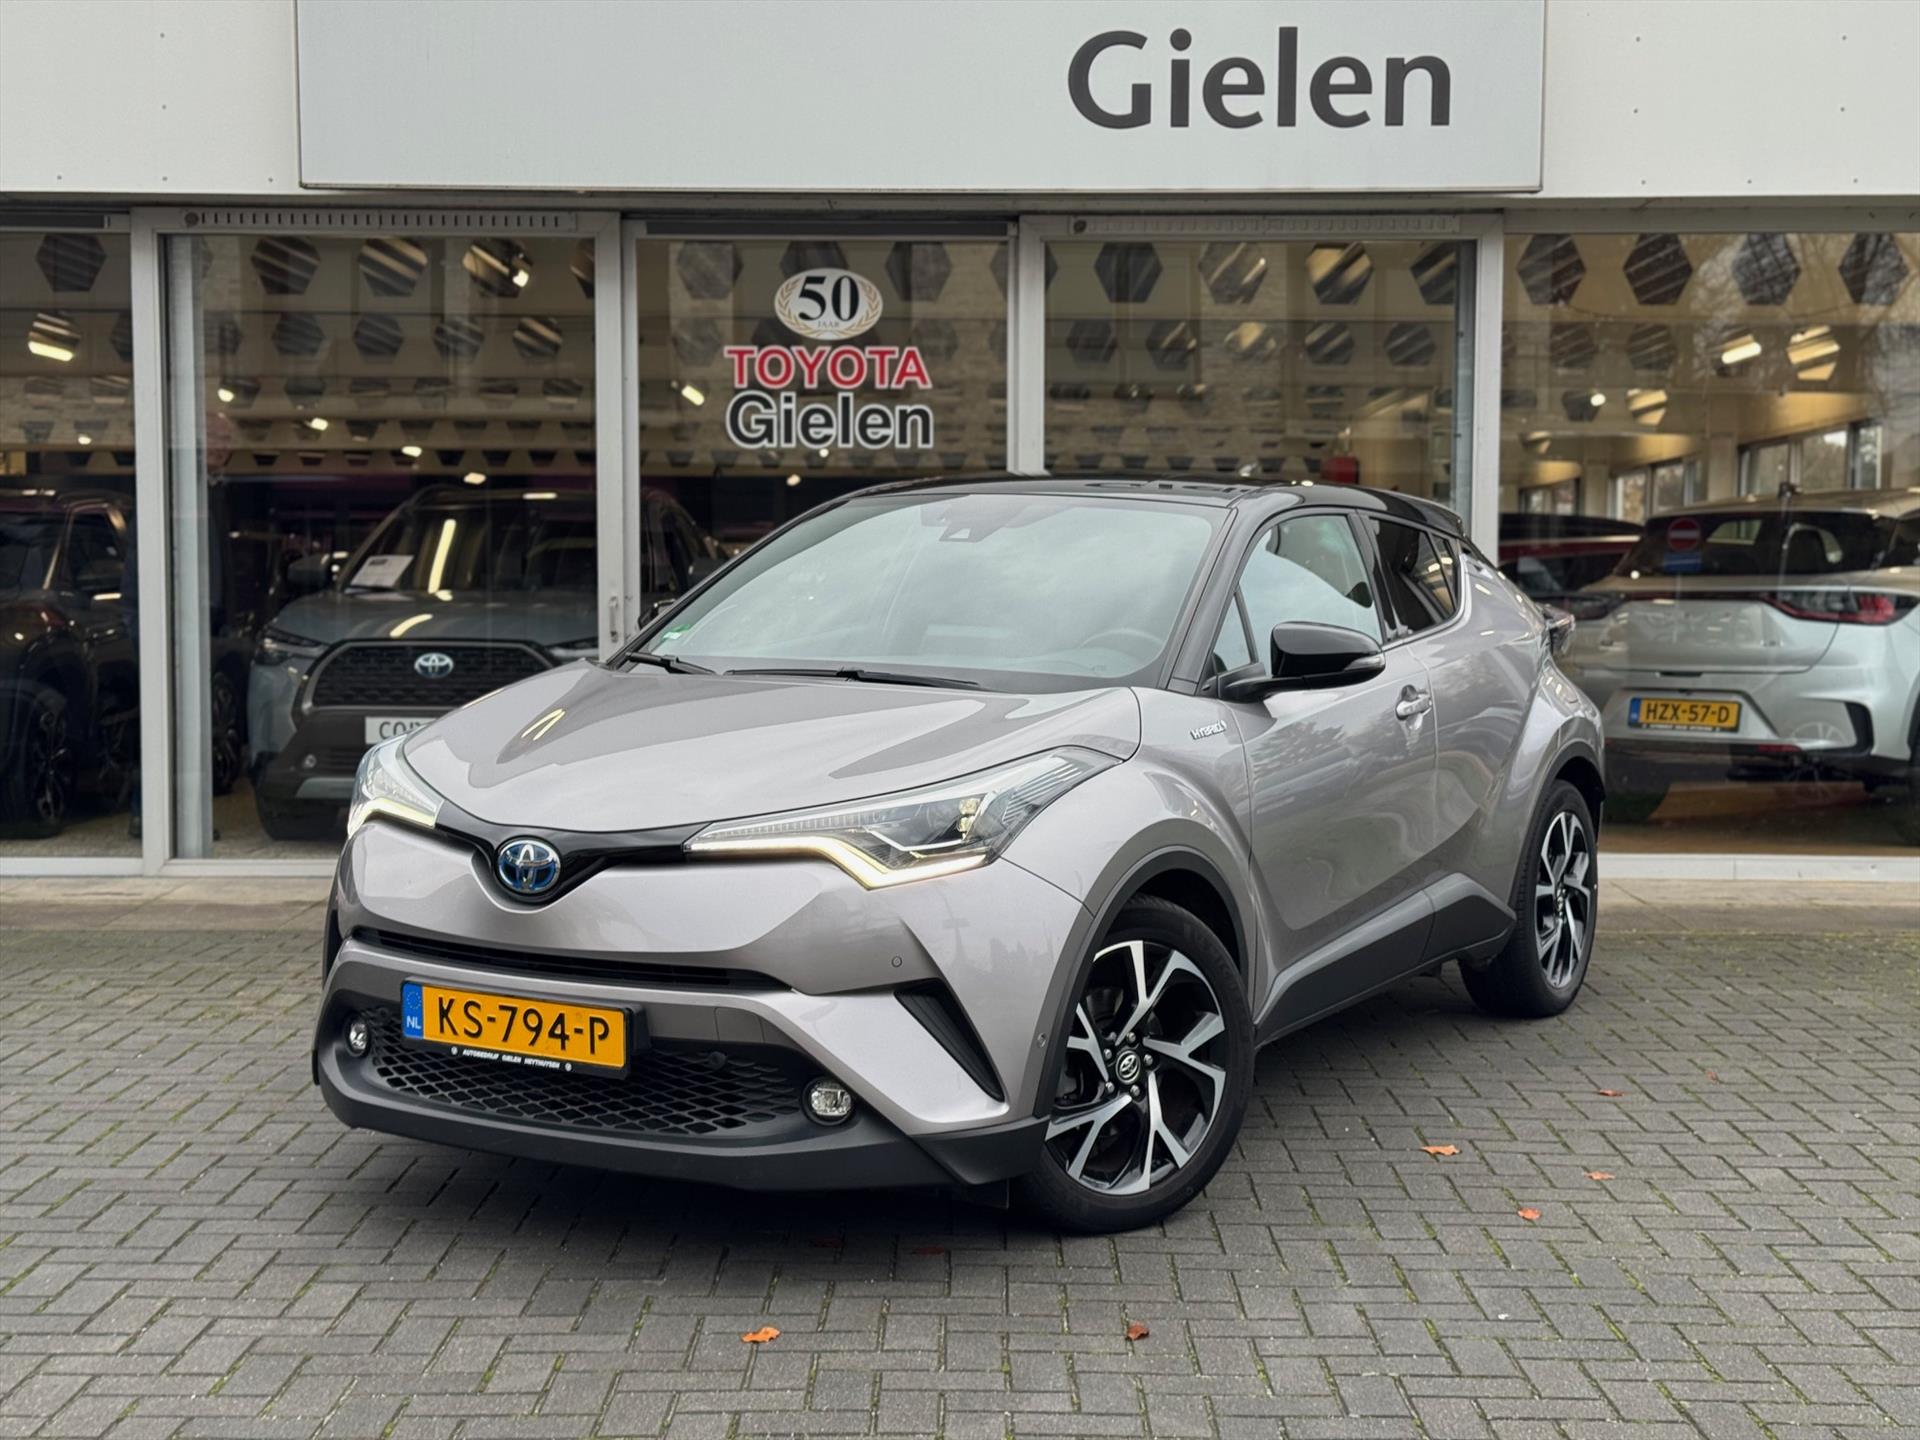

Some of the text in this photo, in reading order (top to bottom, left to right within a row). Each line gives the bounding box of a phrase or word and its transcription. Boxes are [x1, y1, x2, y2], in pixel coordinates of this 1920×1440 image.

[1068, 26, 1451, 129] Gielen
[798, 275, 860, 322] 50
[817, 320, 840, 329] JAAR
[724, 345, 933, 389] TOYOTA
[726, 390, 934, 448] Gielen
[1646, 703, 1730, 723] HZX-57-D
[406, 1016, 421, 1030] NL
[438, 997, 610, 1055] KS-794-P
